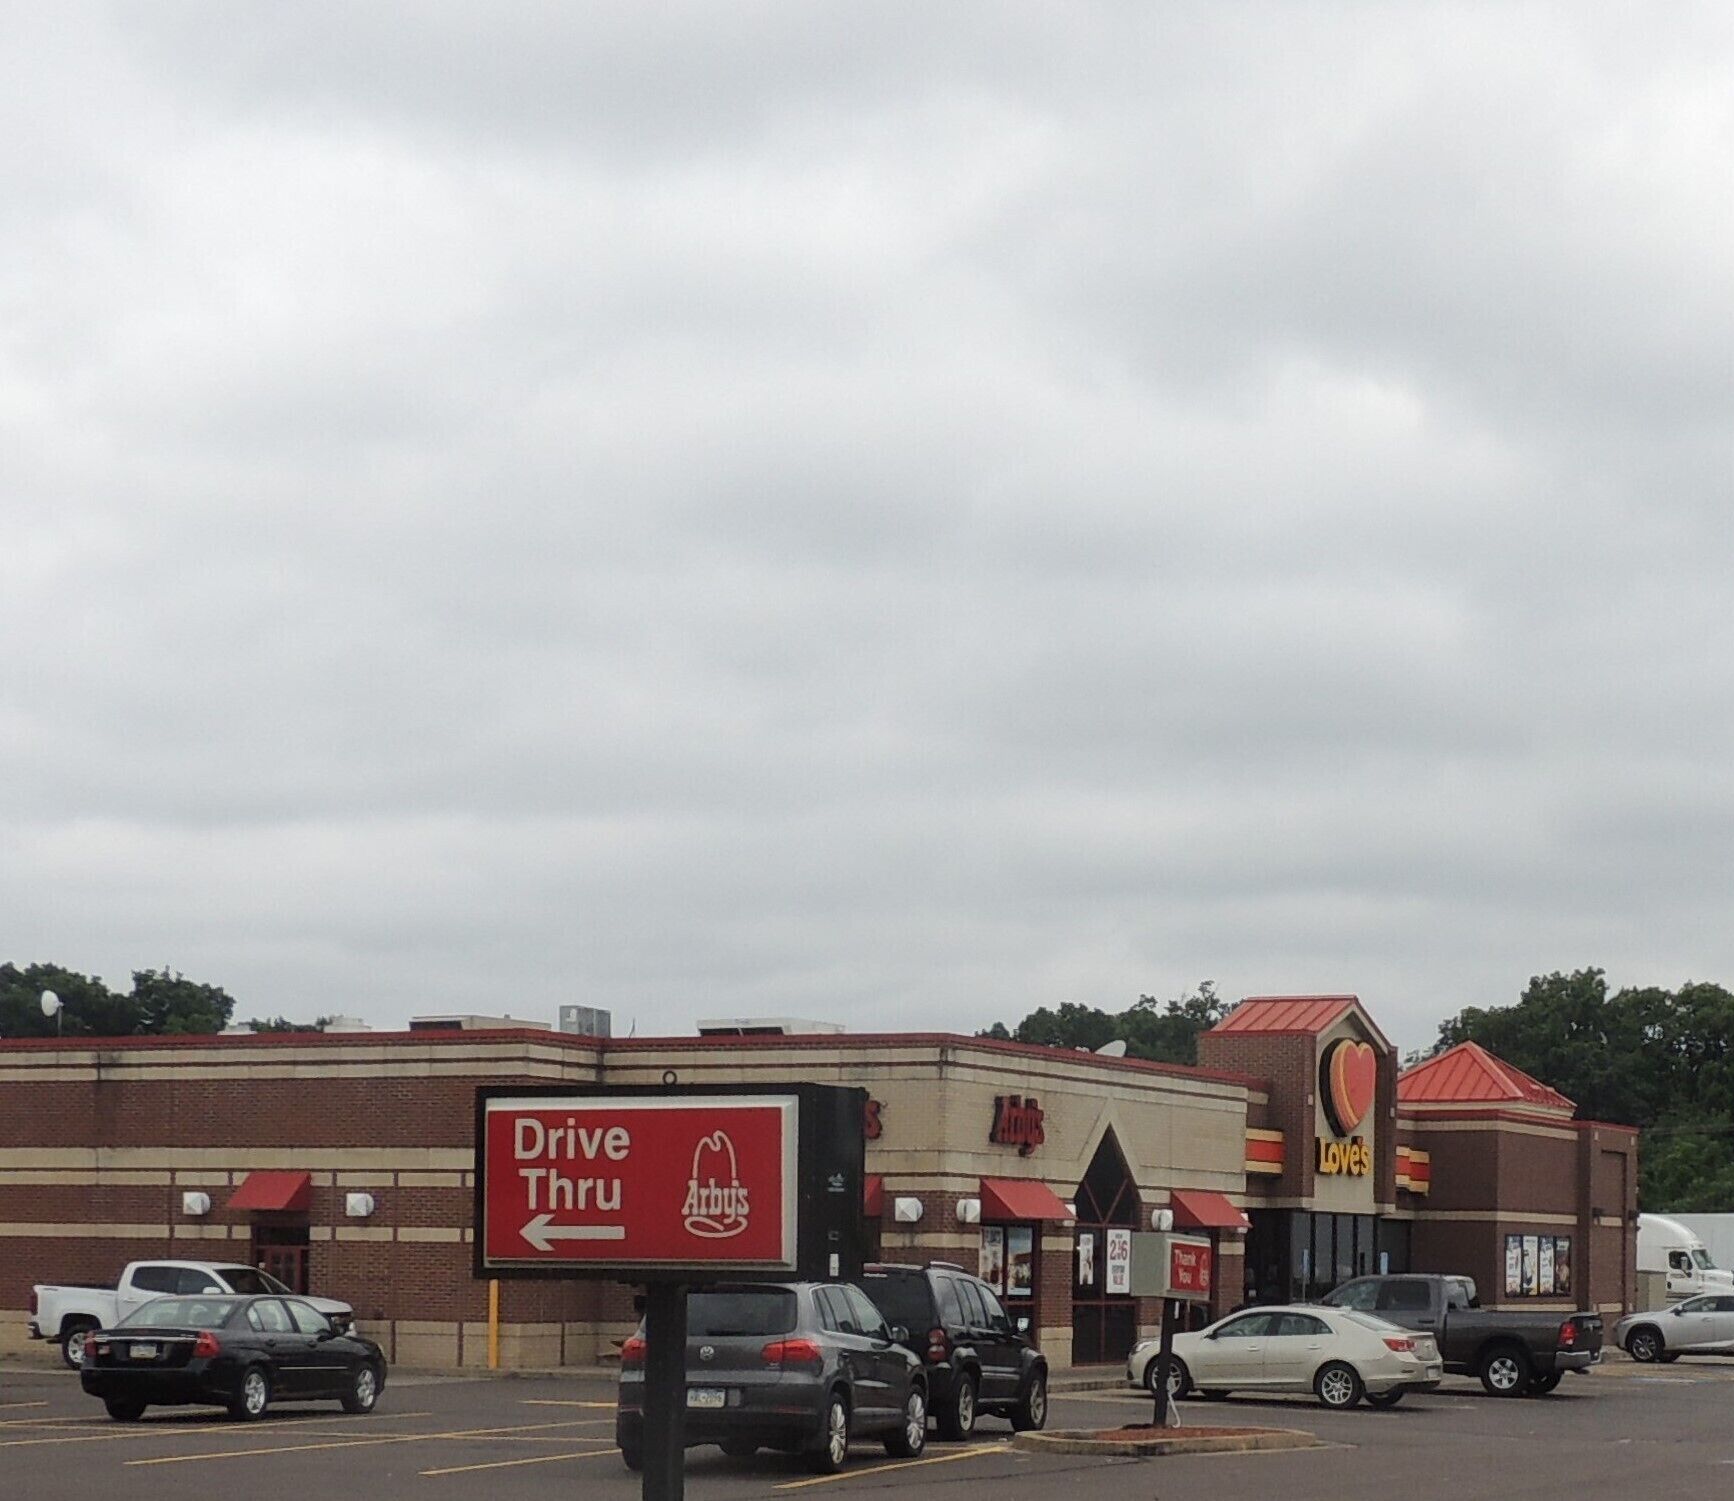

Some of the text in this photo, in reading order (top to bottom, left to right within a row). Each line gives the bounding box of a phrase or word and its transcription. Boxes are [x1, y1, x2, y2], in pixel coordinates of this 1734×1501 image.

[514, 1117, 631, 1161] Drive
[1315, 1135, 1370, 1176] Love's
[518, 1167, 622, 1211] Thru
[681, 1178, 749, 1224] Arby's
[1174, 1249, 1196, 1266] Thank
[1178, 1267, 1192, 1284] You
